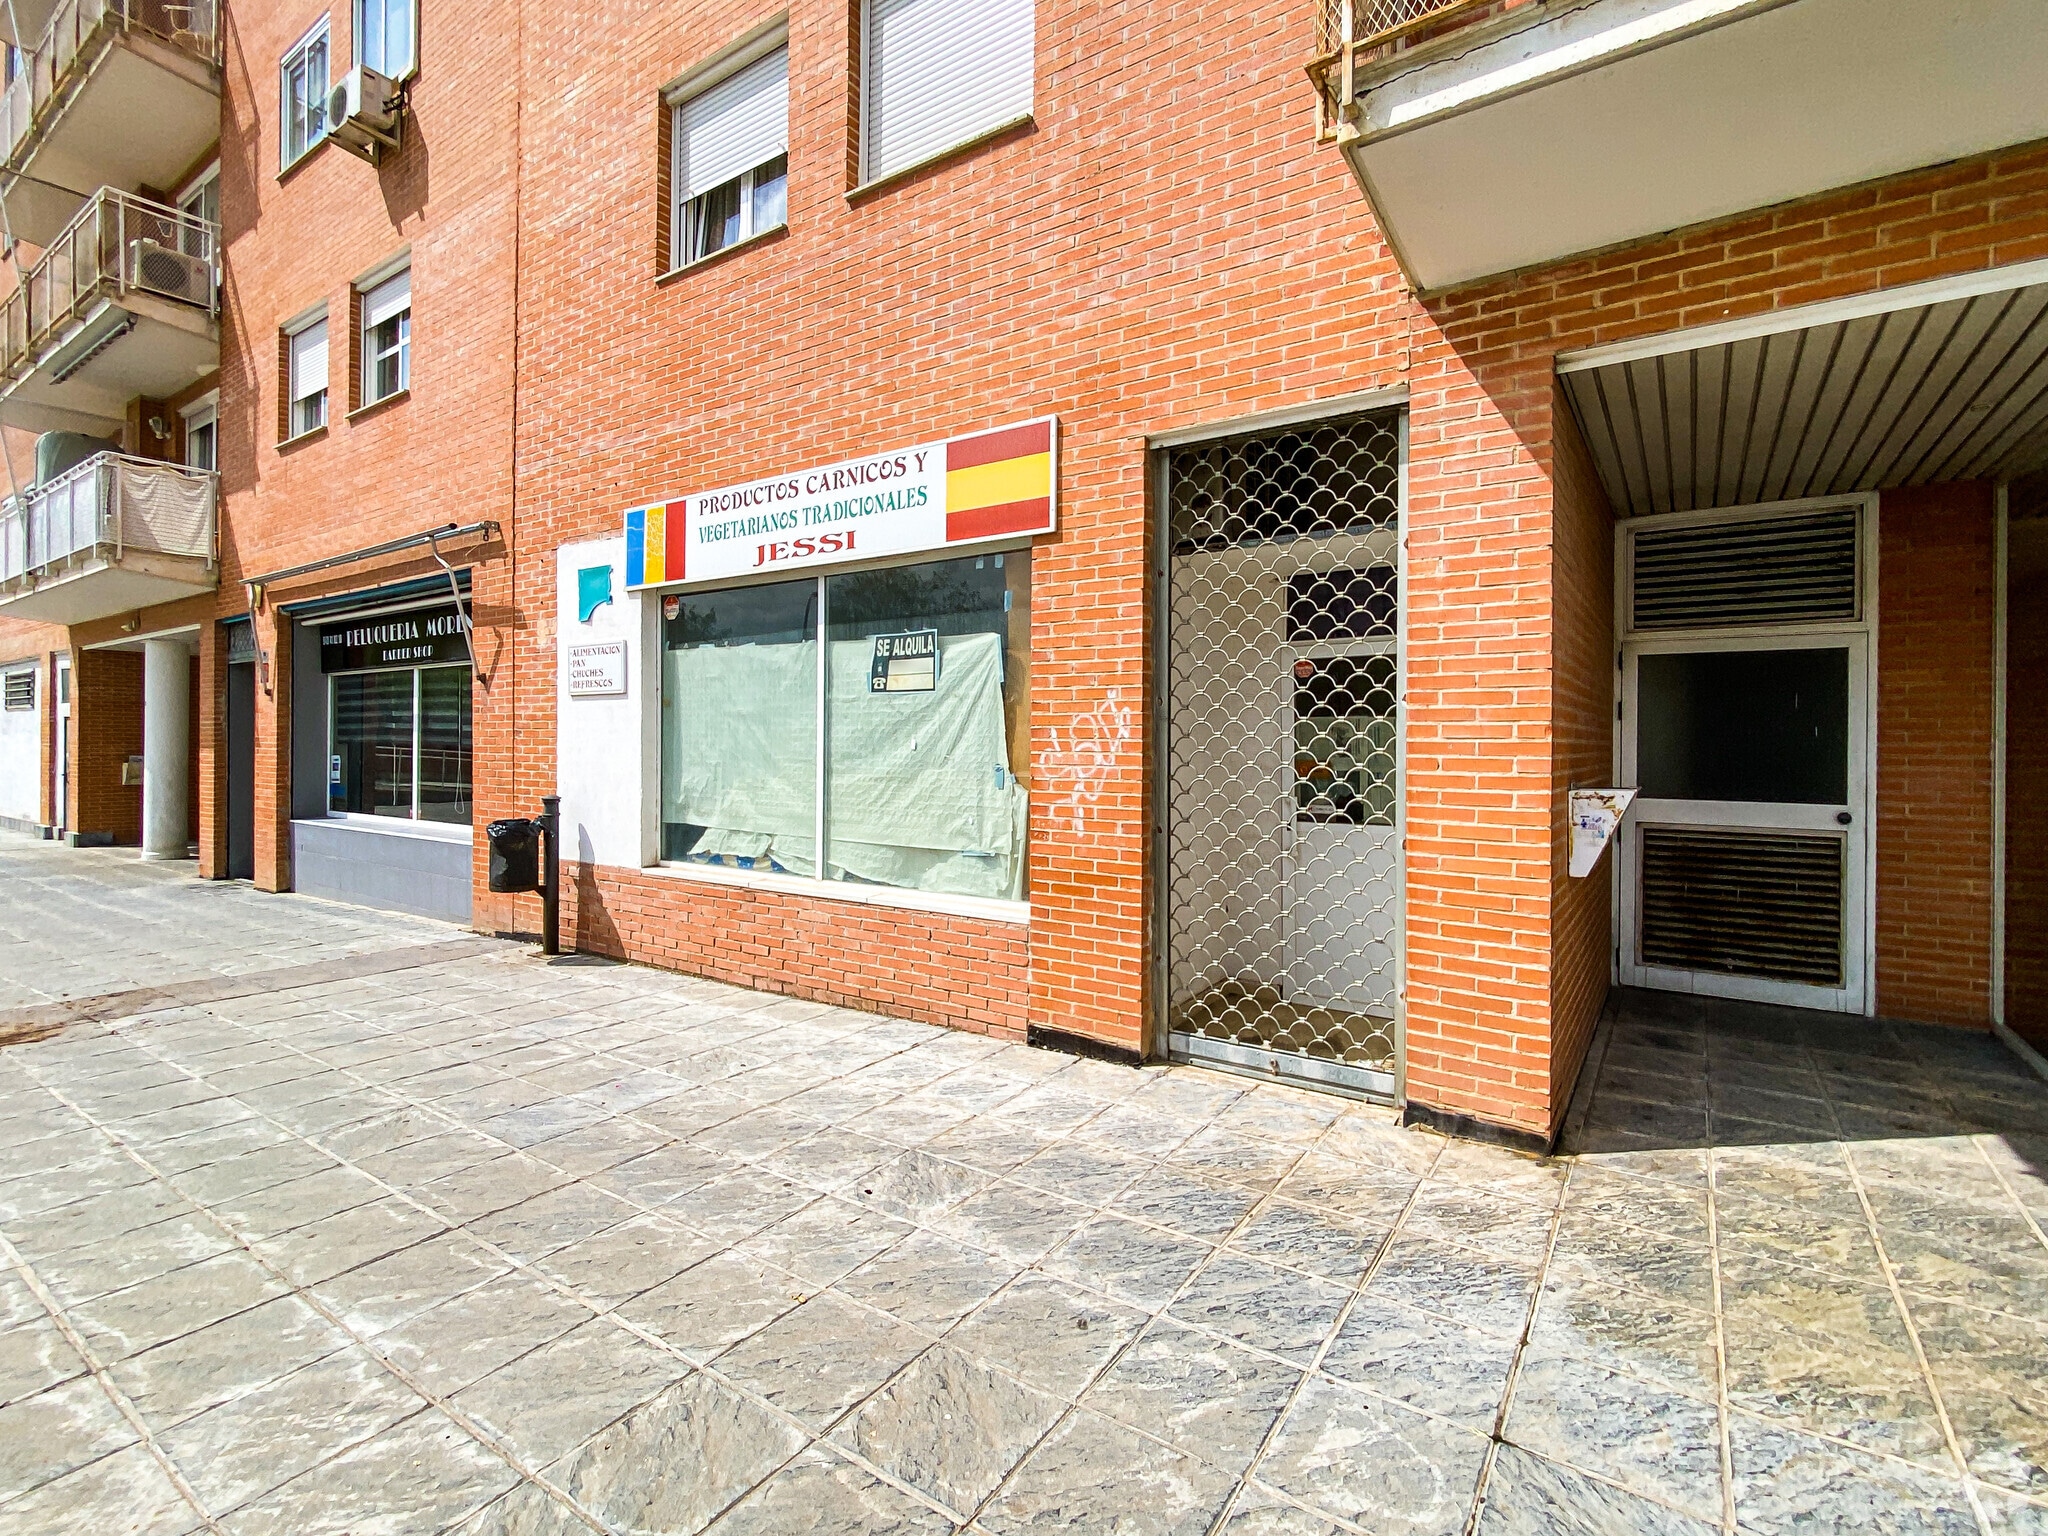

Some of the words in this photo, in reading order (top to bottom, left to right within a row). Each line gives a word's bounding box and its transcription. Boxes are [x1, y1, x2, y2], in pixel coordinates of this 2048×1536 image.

[699, 479, 799, 516] PRODUCTOS
[806, 456, 907, 495] CARNICOS
[914, 450, 928, 473] Y
[699, 509, 798, 544] VEGETARIANOS
[802, 485, 928, 526] TRADICIONALES
[753, 530, 857, 567] JESSI
[346, 621, 419, 647] PELUQUERIA
[876, 638, 890, 657] SE
[892, 634, 934, 657] ALQUILA
[382, 648, 412, 662] BARBER
[413, 645, 434, 659] SHOP
